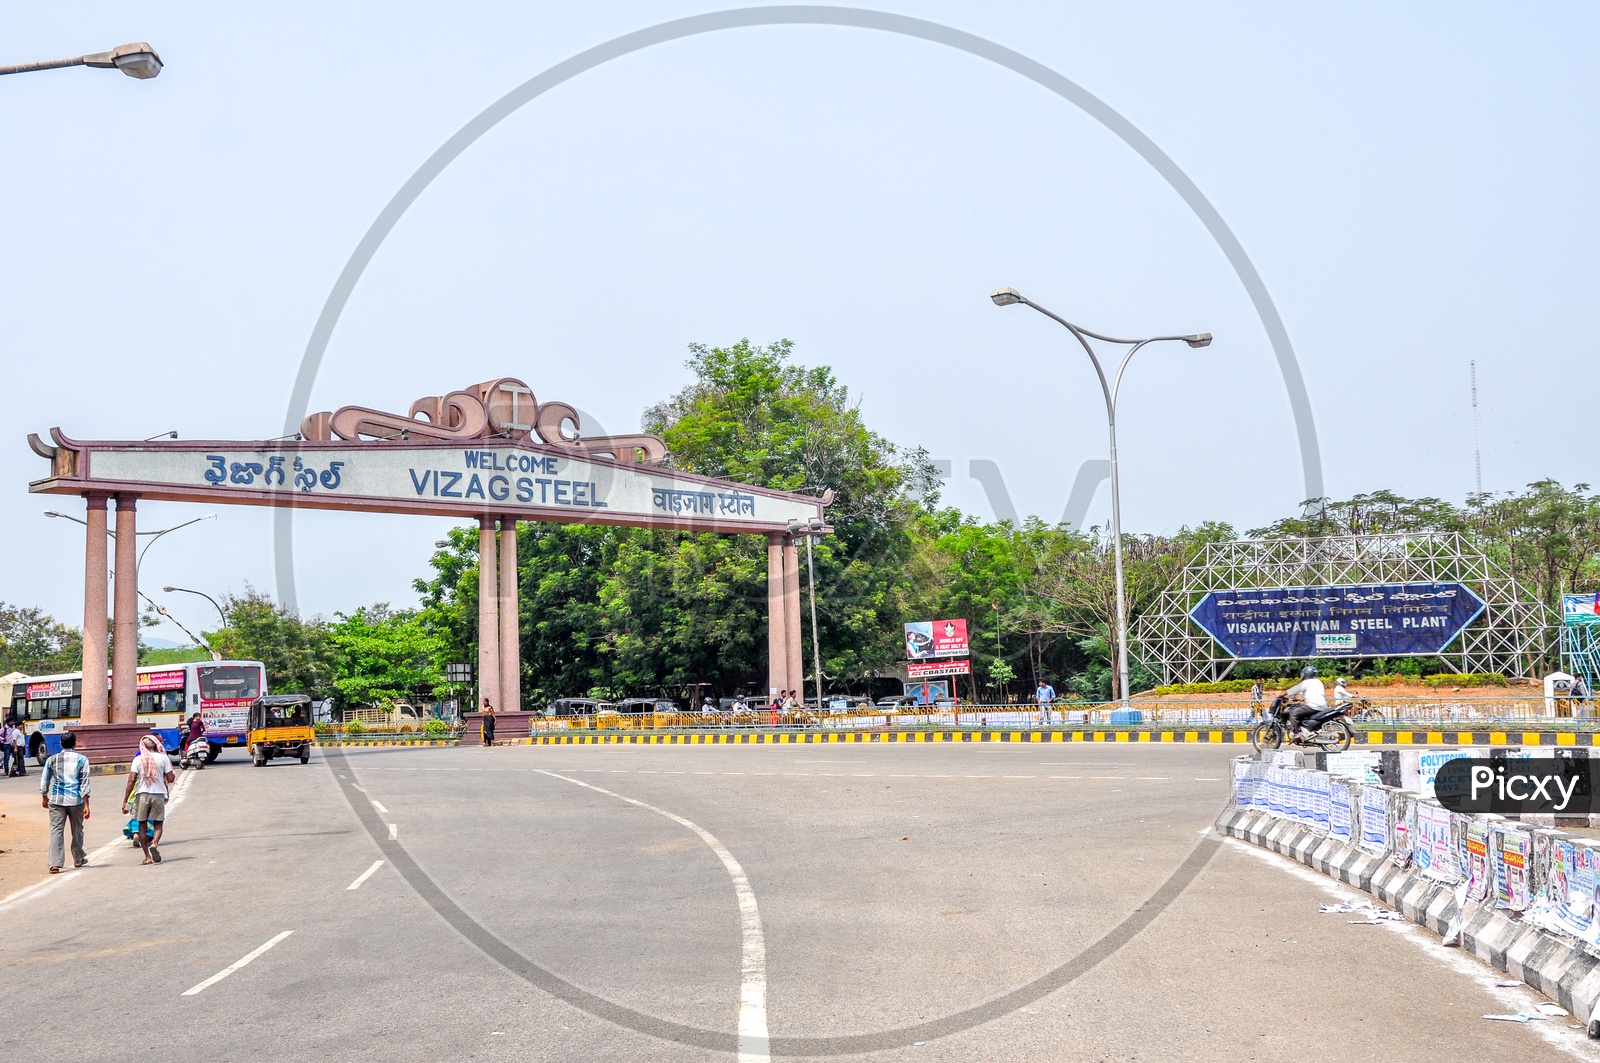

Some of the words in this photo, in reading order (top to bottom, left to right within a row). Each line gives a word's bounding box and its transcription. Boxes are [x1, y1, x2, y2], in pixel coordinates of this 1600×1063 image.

[204, 455, 286, 487] వైజాగ్
[293, 456, 345, 492] స్టీల్
[464, 450, 558, 476] WELCOME
[652, 487, 714, 515] वाइज़ाग
[718, 492, 756, 517] स्टील
[1226, 620, 1340, 634] VISAKHAPATNAM
[1350, 618, 1393, 630] STEEL
[1402, 616, 1448, 628] PLANT
